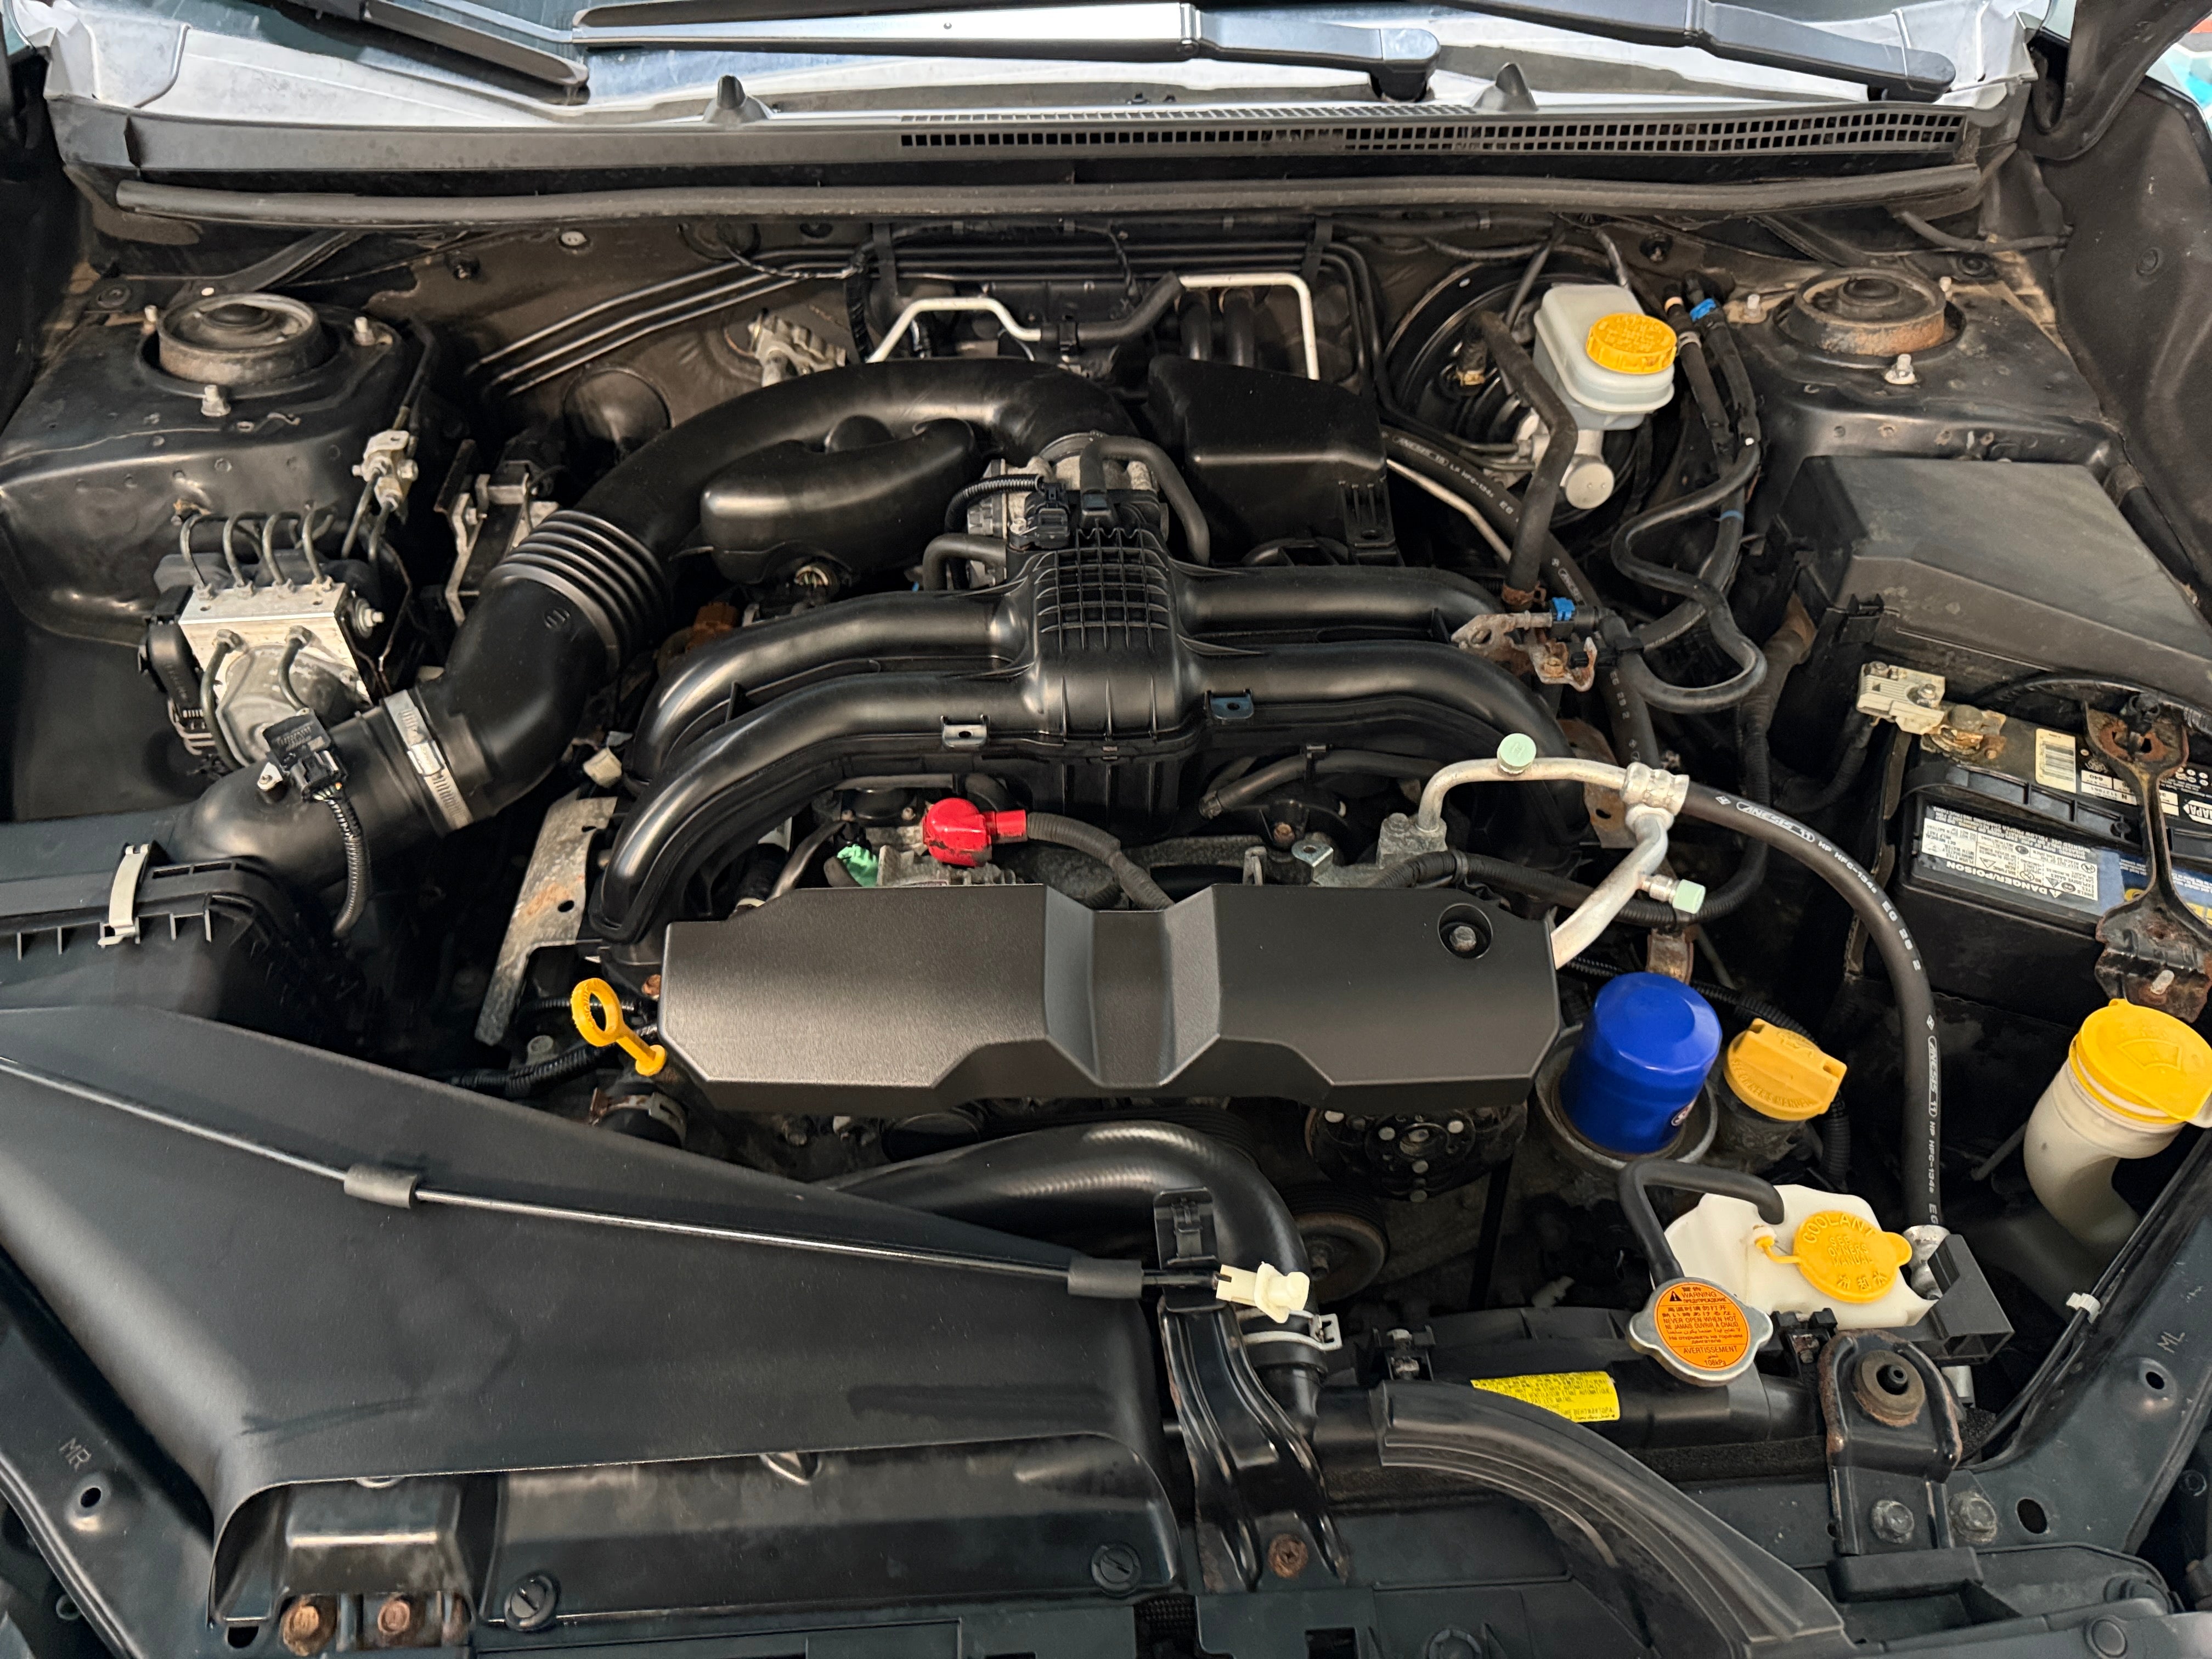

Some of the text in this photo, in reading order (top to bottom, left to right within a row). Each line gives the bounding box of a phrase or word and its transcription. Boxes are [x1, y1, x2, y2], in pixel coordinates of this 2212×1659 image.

[1946, 861, 2047, 895] DANGER/POISON
[1803, 1213, 1877, 1243] COOLANT
[1830, 1235, 1852, 1246] SEE
[1827, 1244, 1869, 1256] OWNERS
[1831, 1257, 1873, 1267] MANUAL
[1684, 1345, 1737, 1354] AVERTISSEMENT
[2157, 1331, 2186, 1354] ML
[59, 1437, 92, 1471] MR
